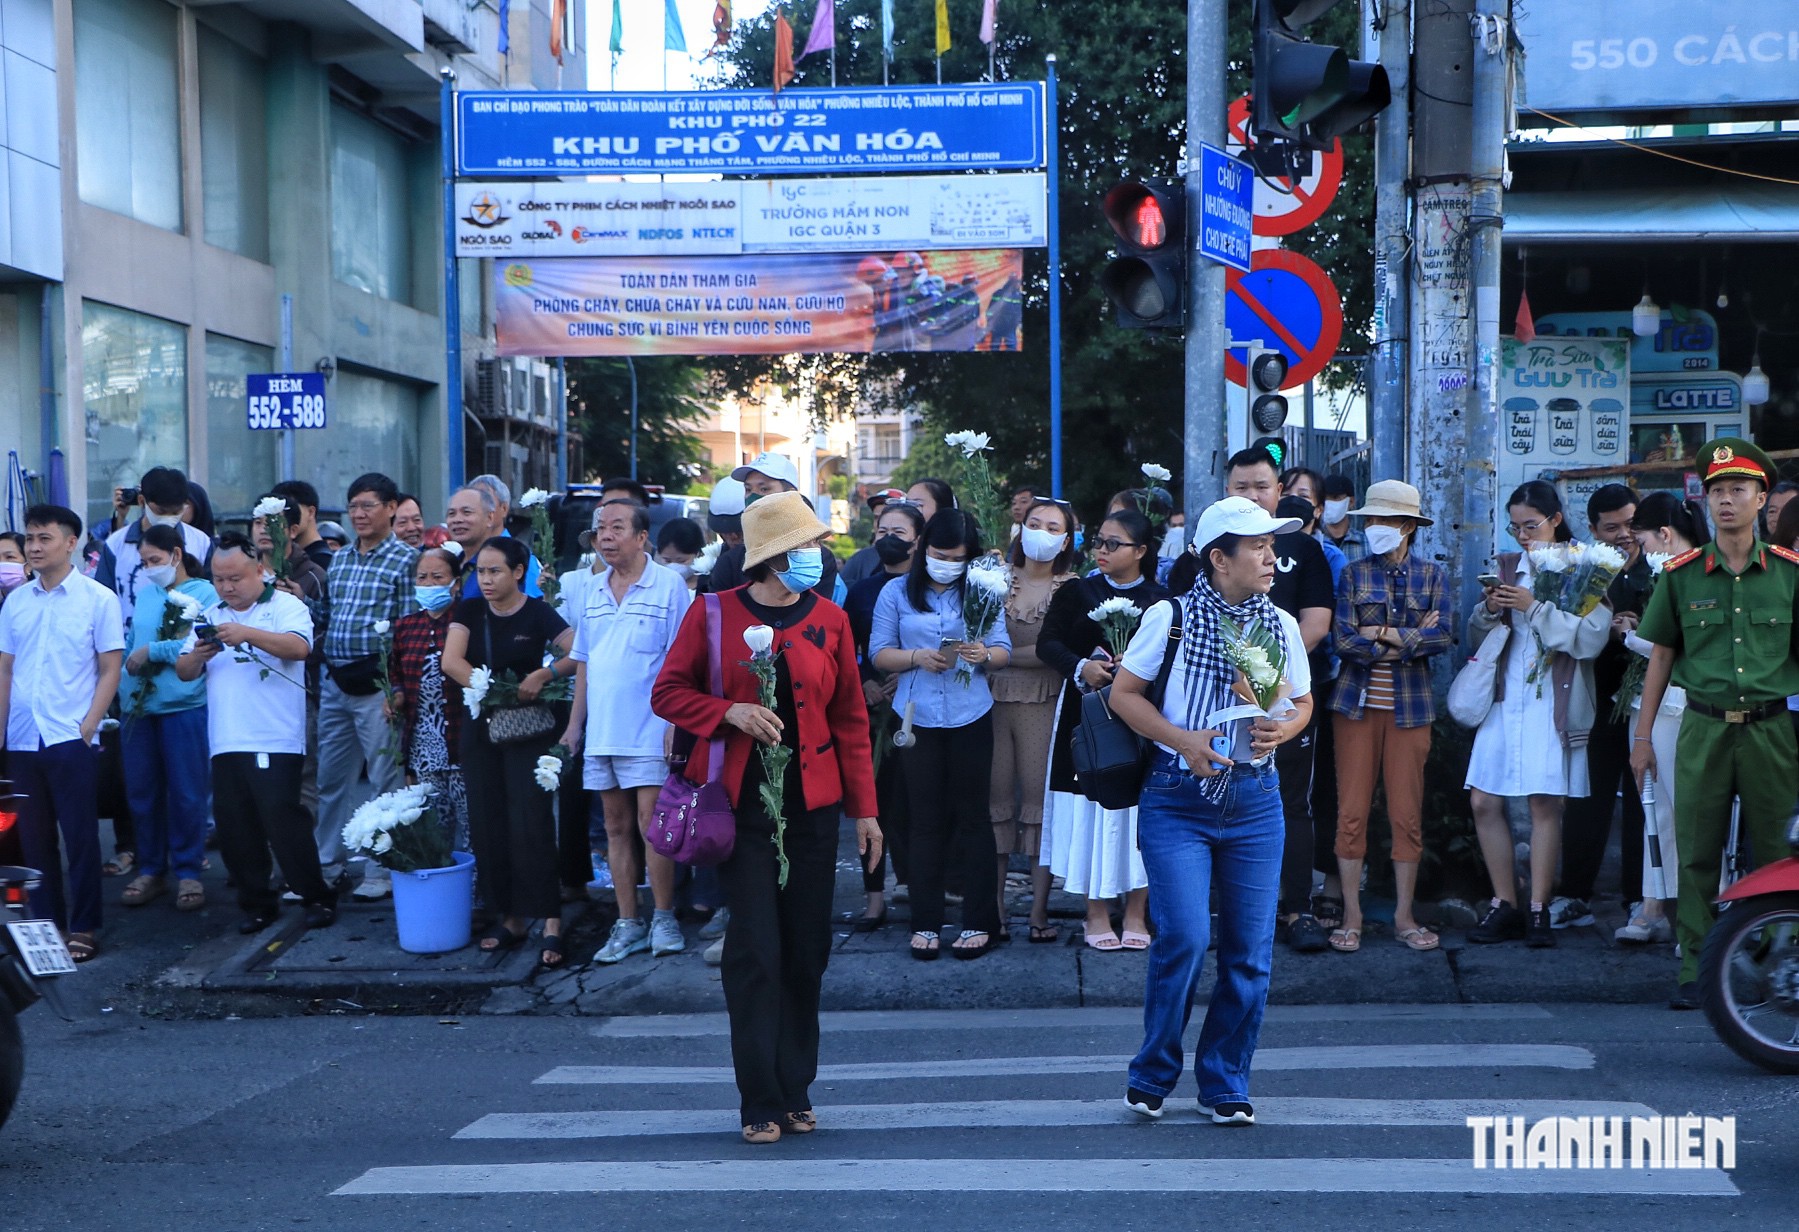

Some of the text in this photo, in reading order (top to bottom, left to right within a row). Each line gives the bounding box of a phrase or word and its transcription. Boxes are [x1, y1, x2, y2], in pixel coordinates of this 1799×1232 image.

[1569, 36, 1658, 71] 550
[472, 100, 492, 113] BAN
[493, 98, 510, 113] CHỈ
[511, 100, 531, 115] ĐẠO
[531, 100, 562, 113] PHONG
[563, 98, 588, 113] TRÀO
[620, 98, 640, 112] DÂN
[641, 98, 666, 112] ĐOÀN
[667, 97, 686, 112] KẾT
[688, 98, 707, 112] XÂY
[777, 96, 796, 110] VĂN
[824, 94, 860, 109] PHƯỜNG
[913, 93, 944, 107] THÀNH
[945, 92, 966, 106] PHỐ
[966, 92, 981, 106] HỒ
[982, 92, 999, 105] CHÍ
[999, 93, 1023, 105] MINH
[668, 110, 827, 129] KHU PHỐ 22
[553, 128, 943, 154] KHU PHỐ VĂN HÓA
[524, 158, 547, 167] 552
[621, 157, 652, 167] CÁCH
[687, 157, 725, 166] THÁNG
[866, 152, 903, 163] THÀNH
[906, 151, 929, 162] PHỐ
[931, 151, 947, 161] HỒ
[949, 151, 969, 161] CHÍ
[971, 151, 1000, 161] MINH
[1217, 165, 1236, 191] CHÚ
[518, 200, 552, 211] CÔNG
[555, 202, 570, 211] TY
[572, 202, 602, 211] PHIM
[605, 199, 638, 210] CÁCH
[679, 199, 708, 210] NGÔI
[711, 200, 736, 209] SAO
[874, 206, 910, 217] NON
[692, 228, 735, 238] NTECH
[789, 221, 881, 239] IGC QUẬN 3
[1205, 226, 1221, 250] CHO
[489, 235, 512, 245] SAO
[620, 271, 757, 289] TOÀN DÂN THAM GIA
[534, 295, 579, 313] PHÒNG
[625, 295, 661, 313] CHỮA
[705, 294, 722, 311] VÀ
[827, 293, 845, 314] HỘ
[568, 322, 614, 337] CHUNG
[618, 319, 645, 336] SỨC
[667, 319, 698, 336] BÌNH
[703, 319, 729, 335] YÊN
[734, 318, 769, 340] CUỘC
[774, 316, 811, 334] SỐNG
[1684, 358, 1708, 368] 2014
